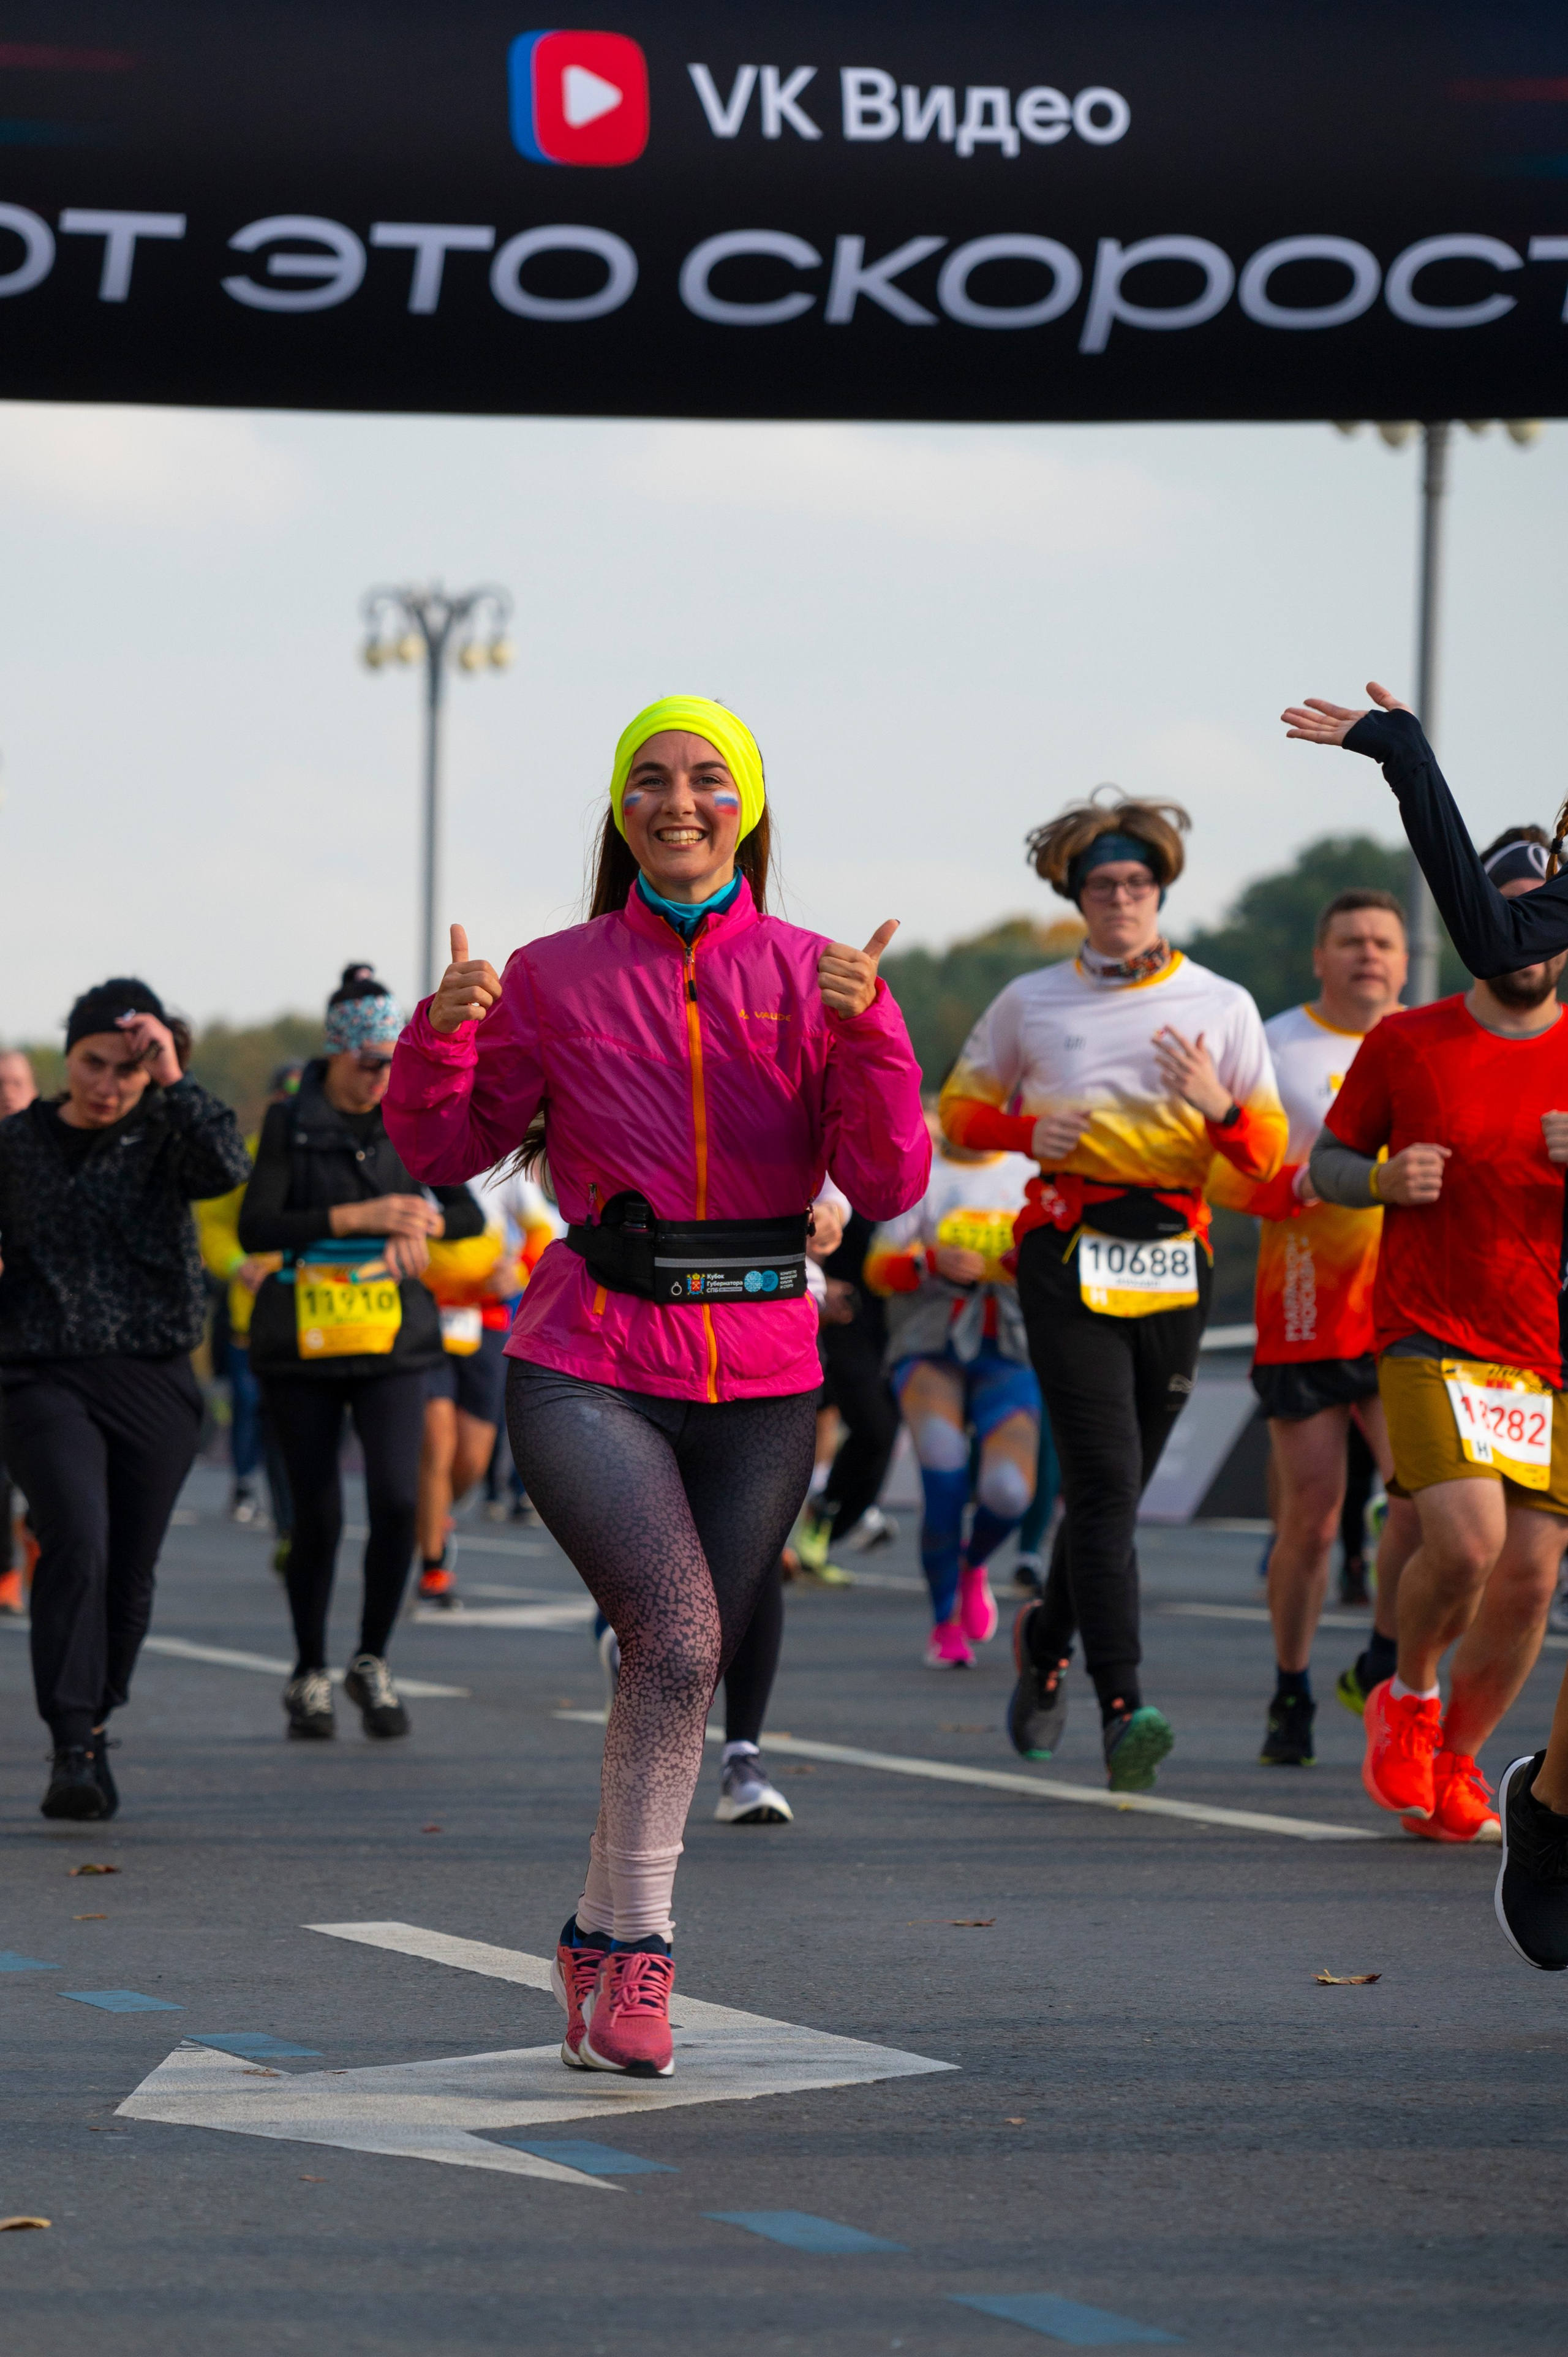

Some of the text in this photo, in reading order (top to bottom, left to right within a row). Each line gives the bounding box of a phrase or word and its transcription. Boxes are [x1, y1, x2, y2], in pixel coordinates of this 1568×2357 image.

[687, 62, 1131, 157] VK Видео
[1088, 1240, 1189, 1277] 10688
